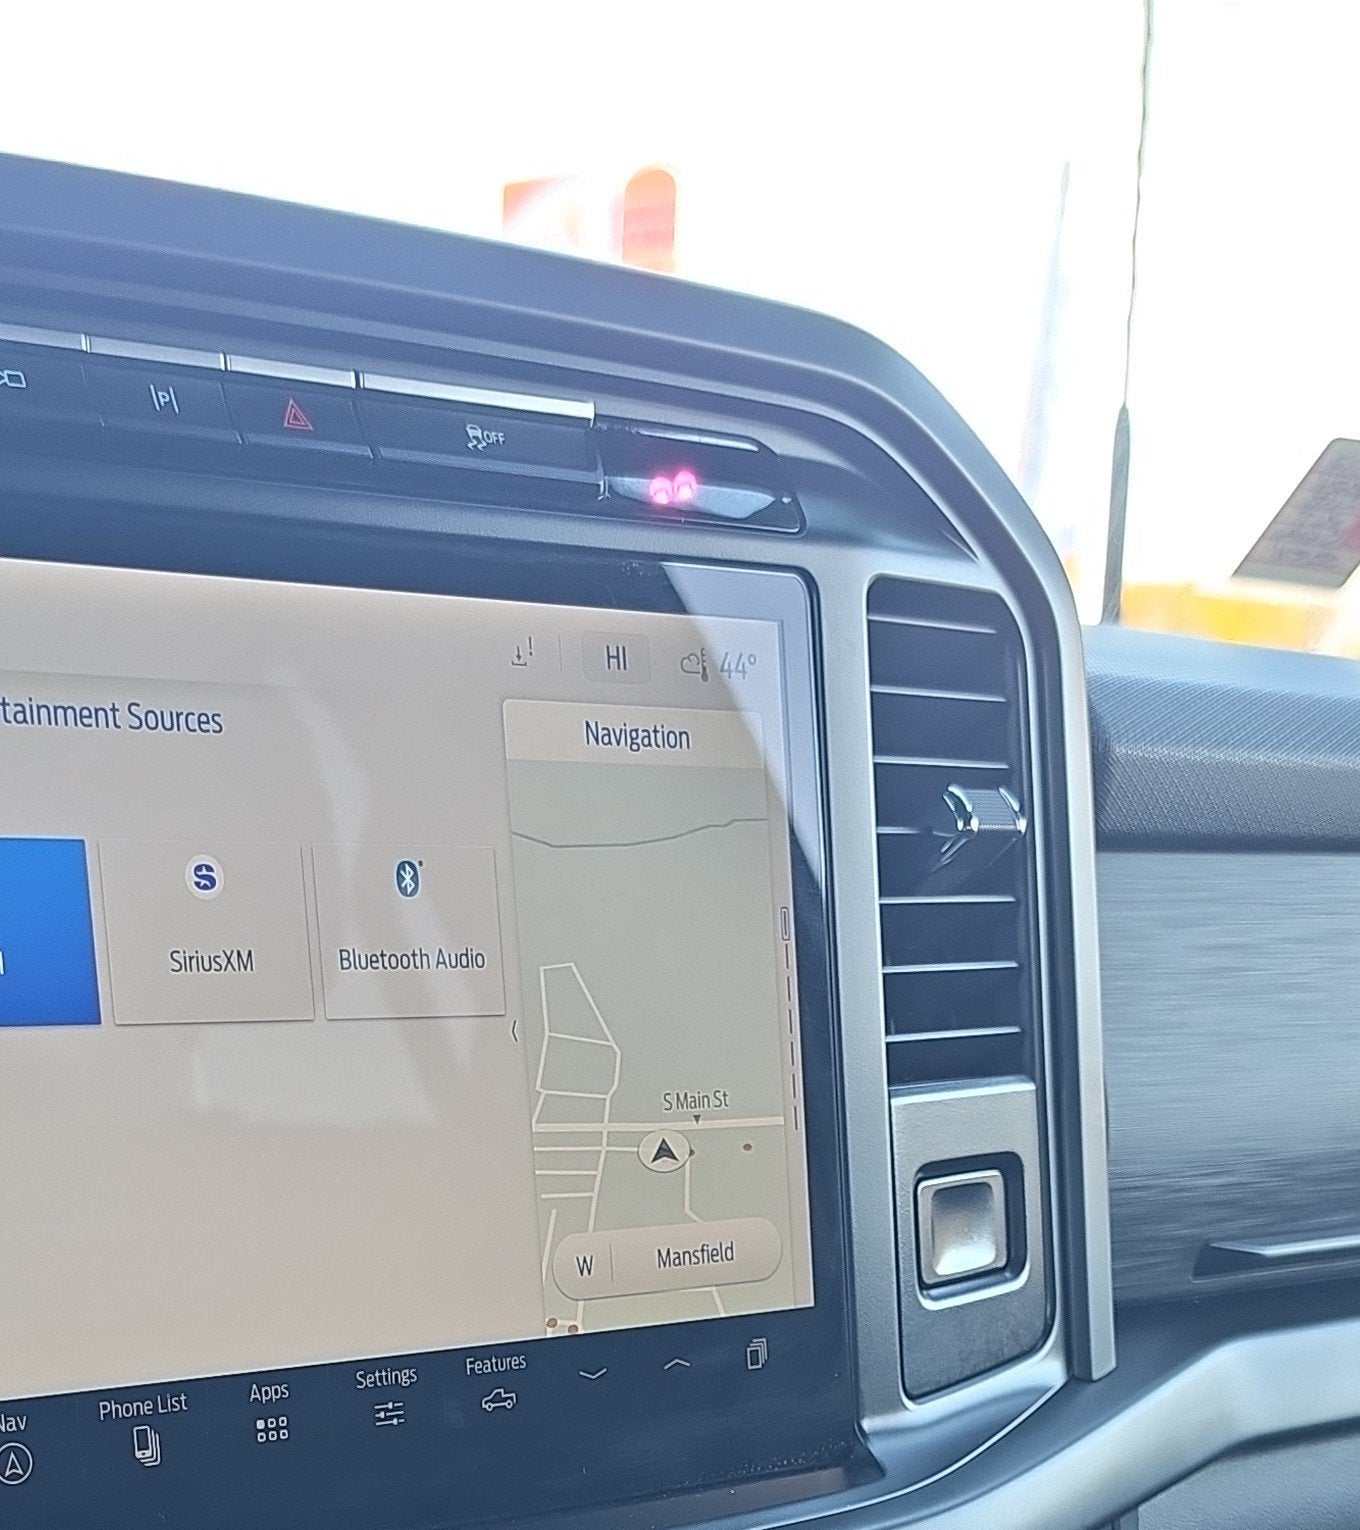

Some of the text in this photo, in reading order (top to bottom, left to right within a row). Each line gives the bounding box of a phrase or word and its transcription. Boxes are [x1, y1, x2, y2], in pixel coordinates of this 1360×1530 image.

[483, 430, 506, 446] OFF
[605, 645, 628, 672] HI
[718, 651, 758, 680] 44°
[127, 702, 225, 736] Sources
[584, 719, 692, 753] Navigation
[169, 947, 255, 976] SiriusXM
[338, 945, 487, 973] Bluetooth Audio
[662, 1089, 730, 1112] S Main St
[575, 1255, 594, 1278] W
[656, 1240, 736, 1271] Mansfield
[464, 1352, 528, 1376] Features
[355, 1365, 418, 1392] Settings
[97, 1392, 189, 1422] Phone List
[249, 1382, 290, 1407] Apps
